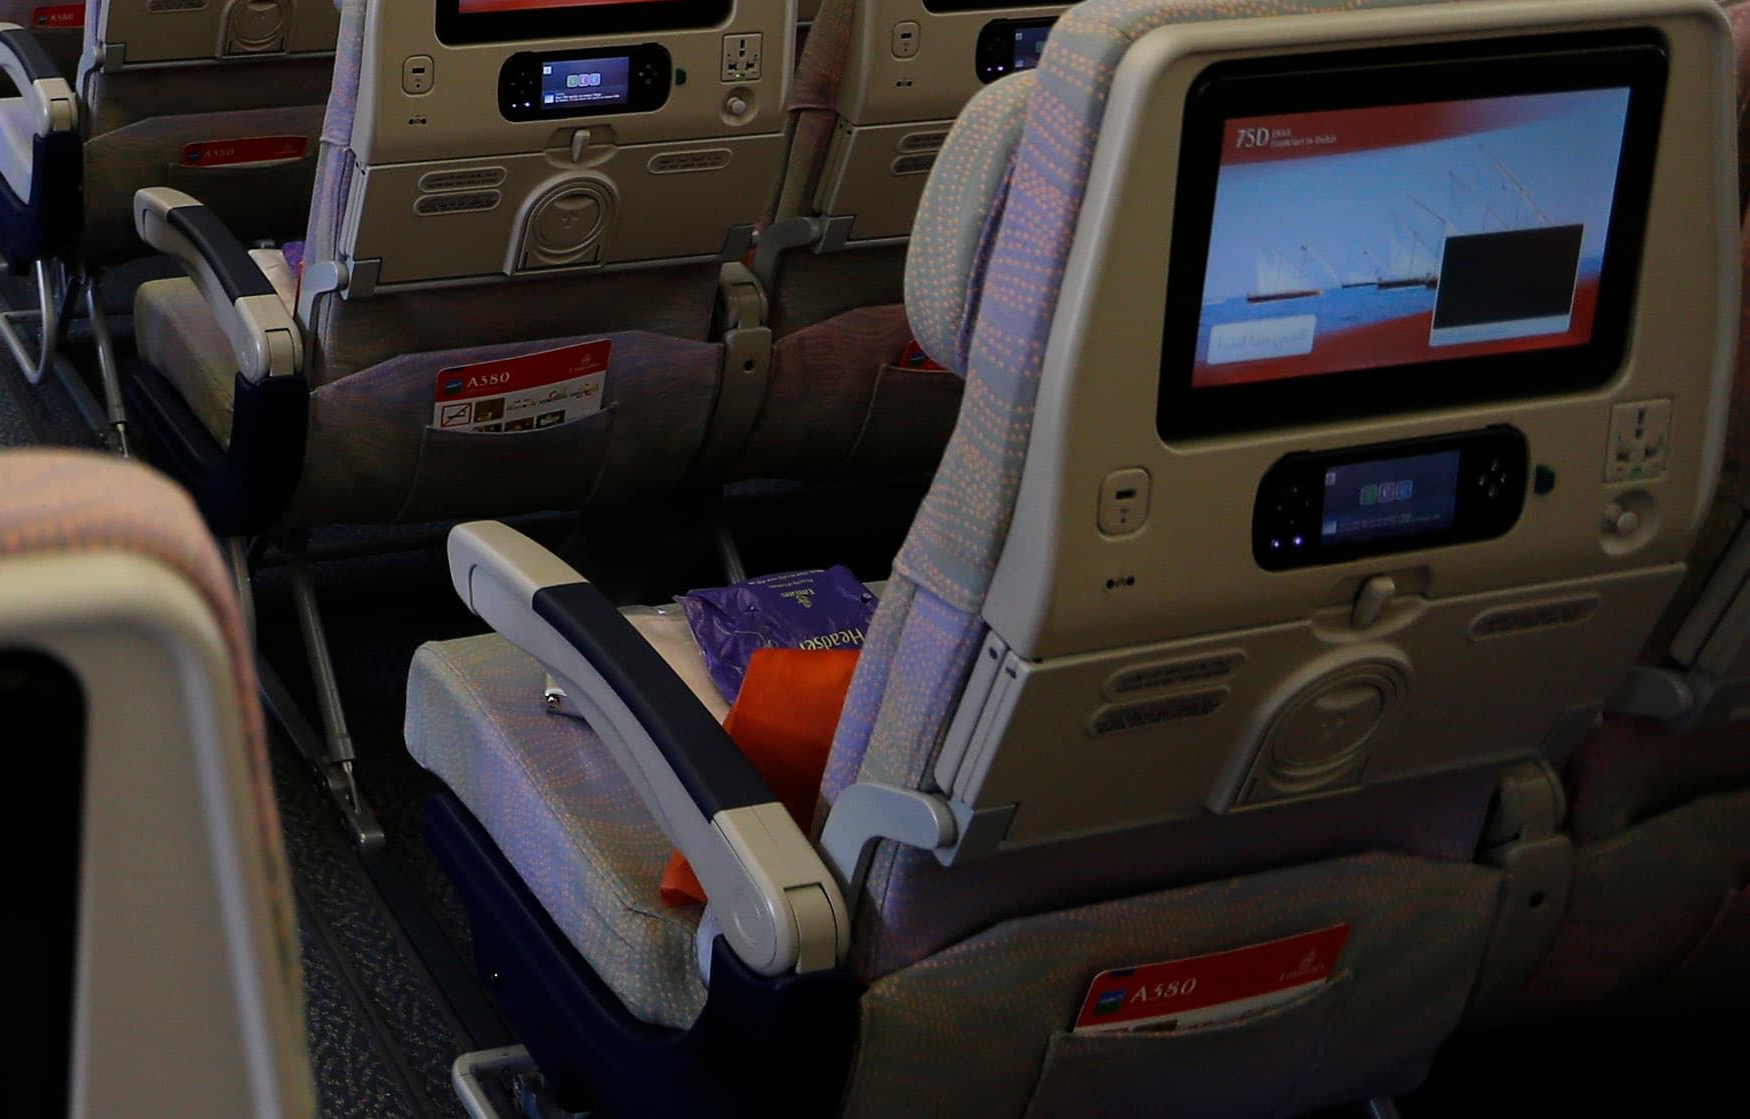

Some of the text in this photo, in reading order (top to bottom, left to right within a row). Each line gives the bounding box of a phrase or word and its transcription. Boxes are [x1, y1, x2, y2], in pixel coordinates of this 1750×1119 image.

[1236, 128, 1270, 149] 75D
[467, 371, 510, 389] A380
[1129, 977, 1197, 1004] A380
